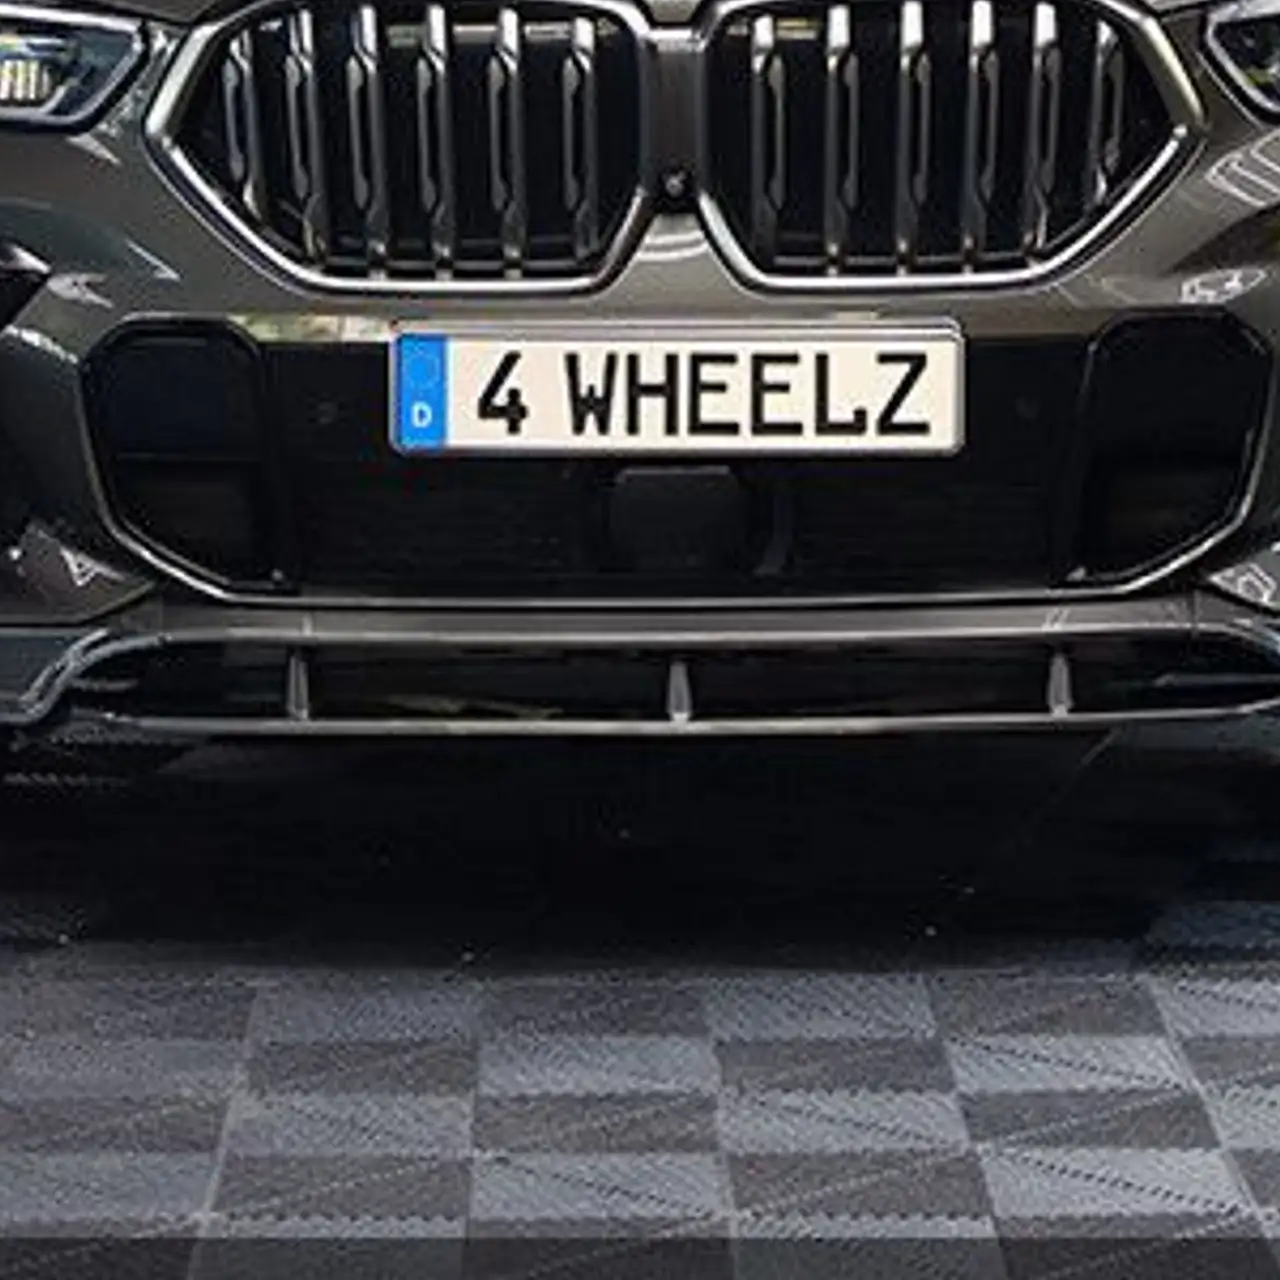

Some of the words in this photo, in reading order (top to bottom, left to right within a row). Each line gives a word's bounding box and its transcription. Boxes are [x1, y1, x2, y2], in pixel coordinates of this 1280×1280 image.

[412, 403, 432, 427] D
[477, 351, 528, 436] 4
[564, 352, 930, 436] WHEELZ
